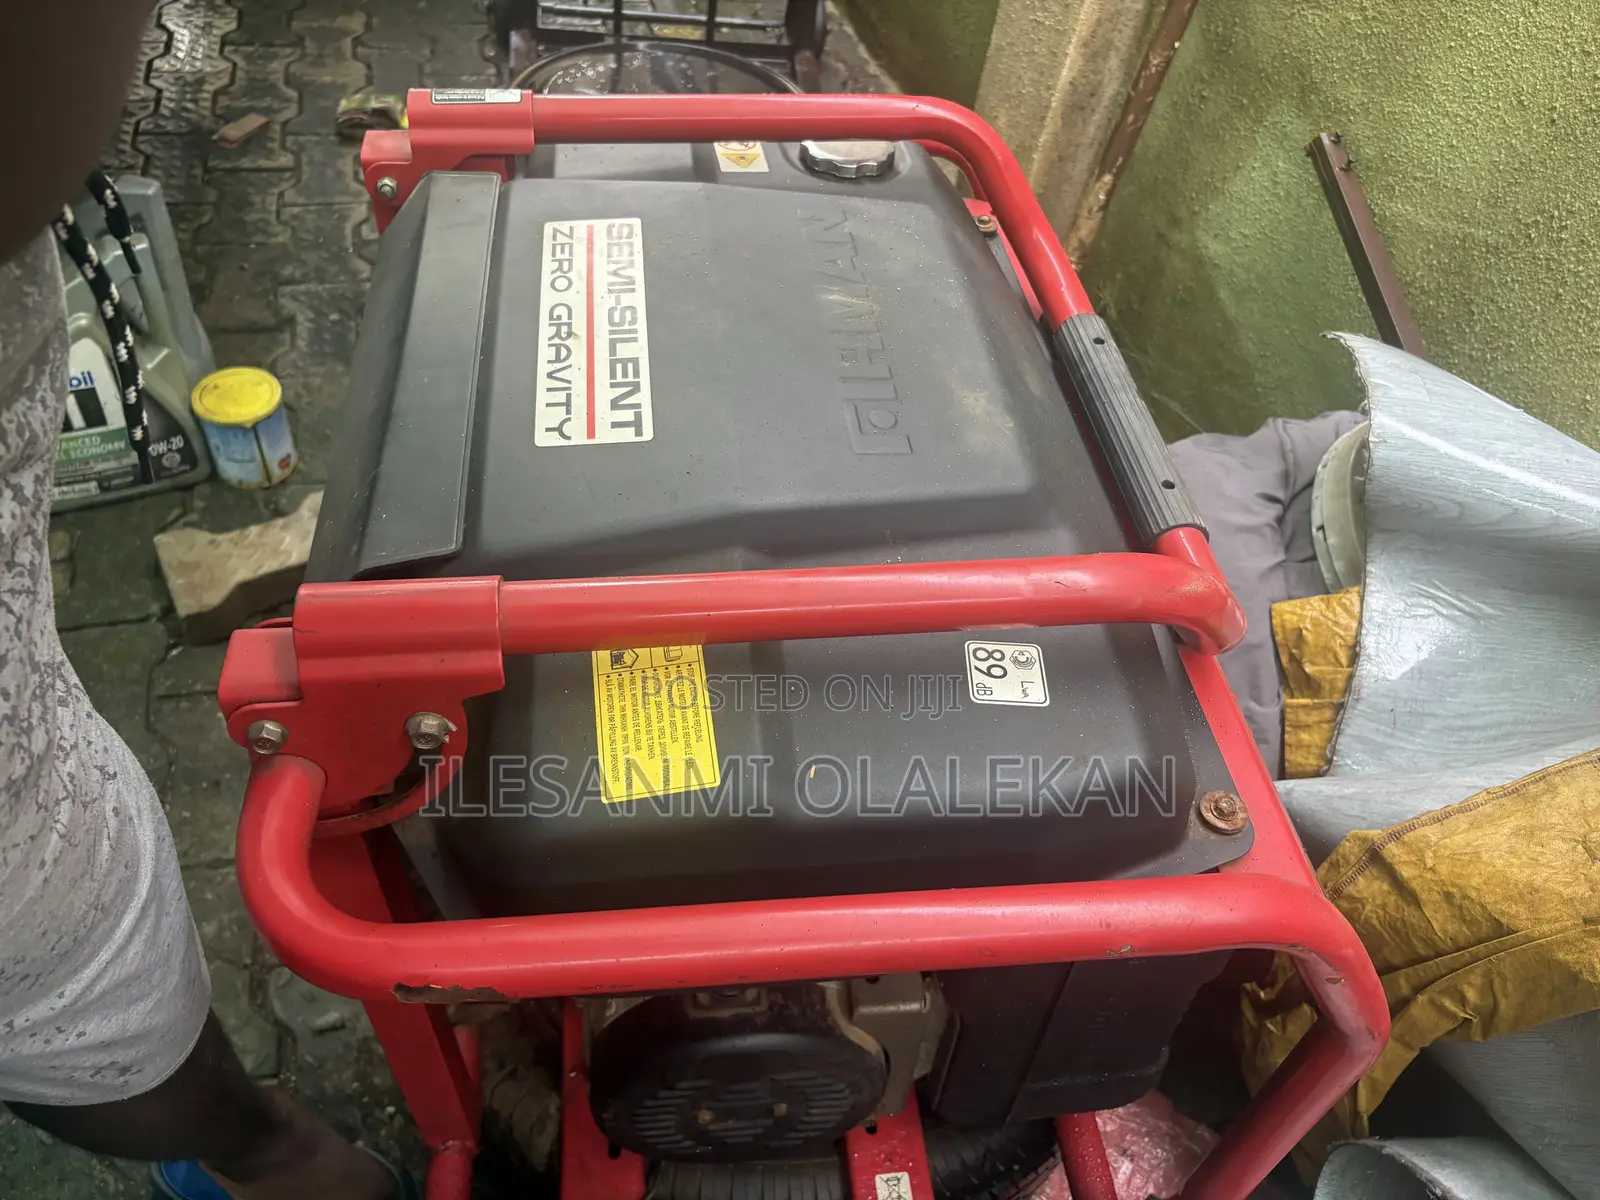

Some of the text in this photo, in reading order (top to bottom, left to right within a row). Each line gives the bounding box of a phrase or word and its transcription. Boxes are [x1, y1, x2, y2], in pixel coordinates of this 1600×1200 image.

[545, 225, 575, 441] ZERO GRAVITY
[605, 222, 644, 438] SEMI-SILENT
[973, 646, 1008, 697] 89 dB
